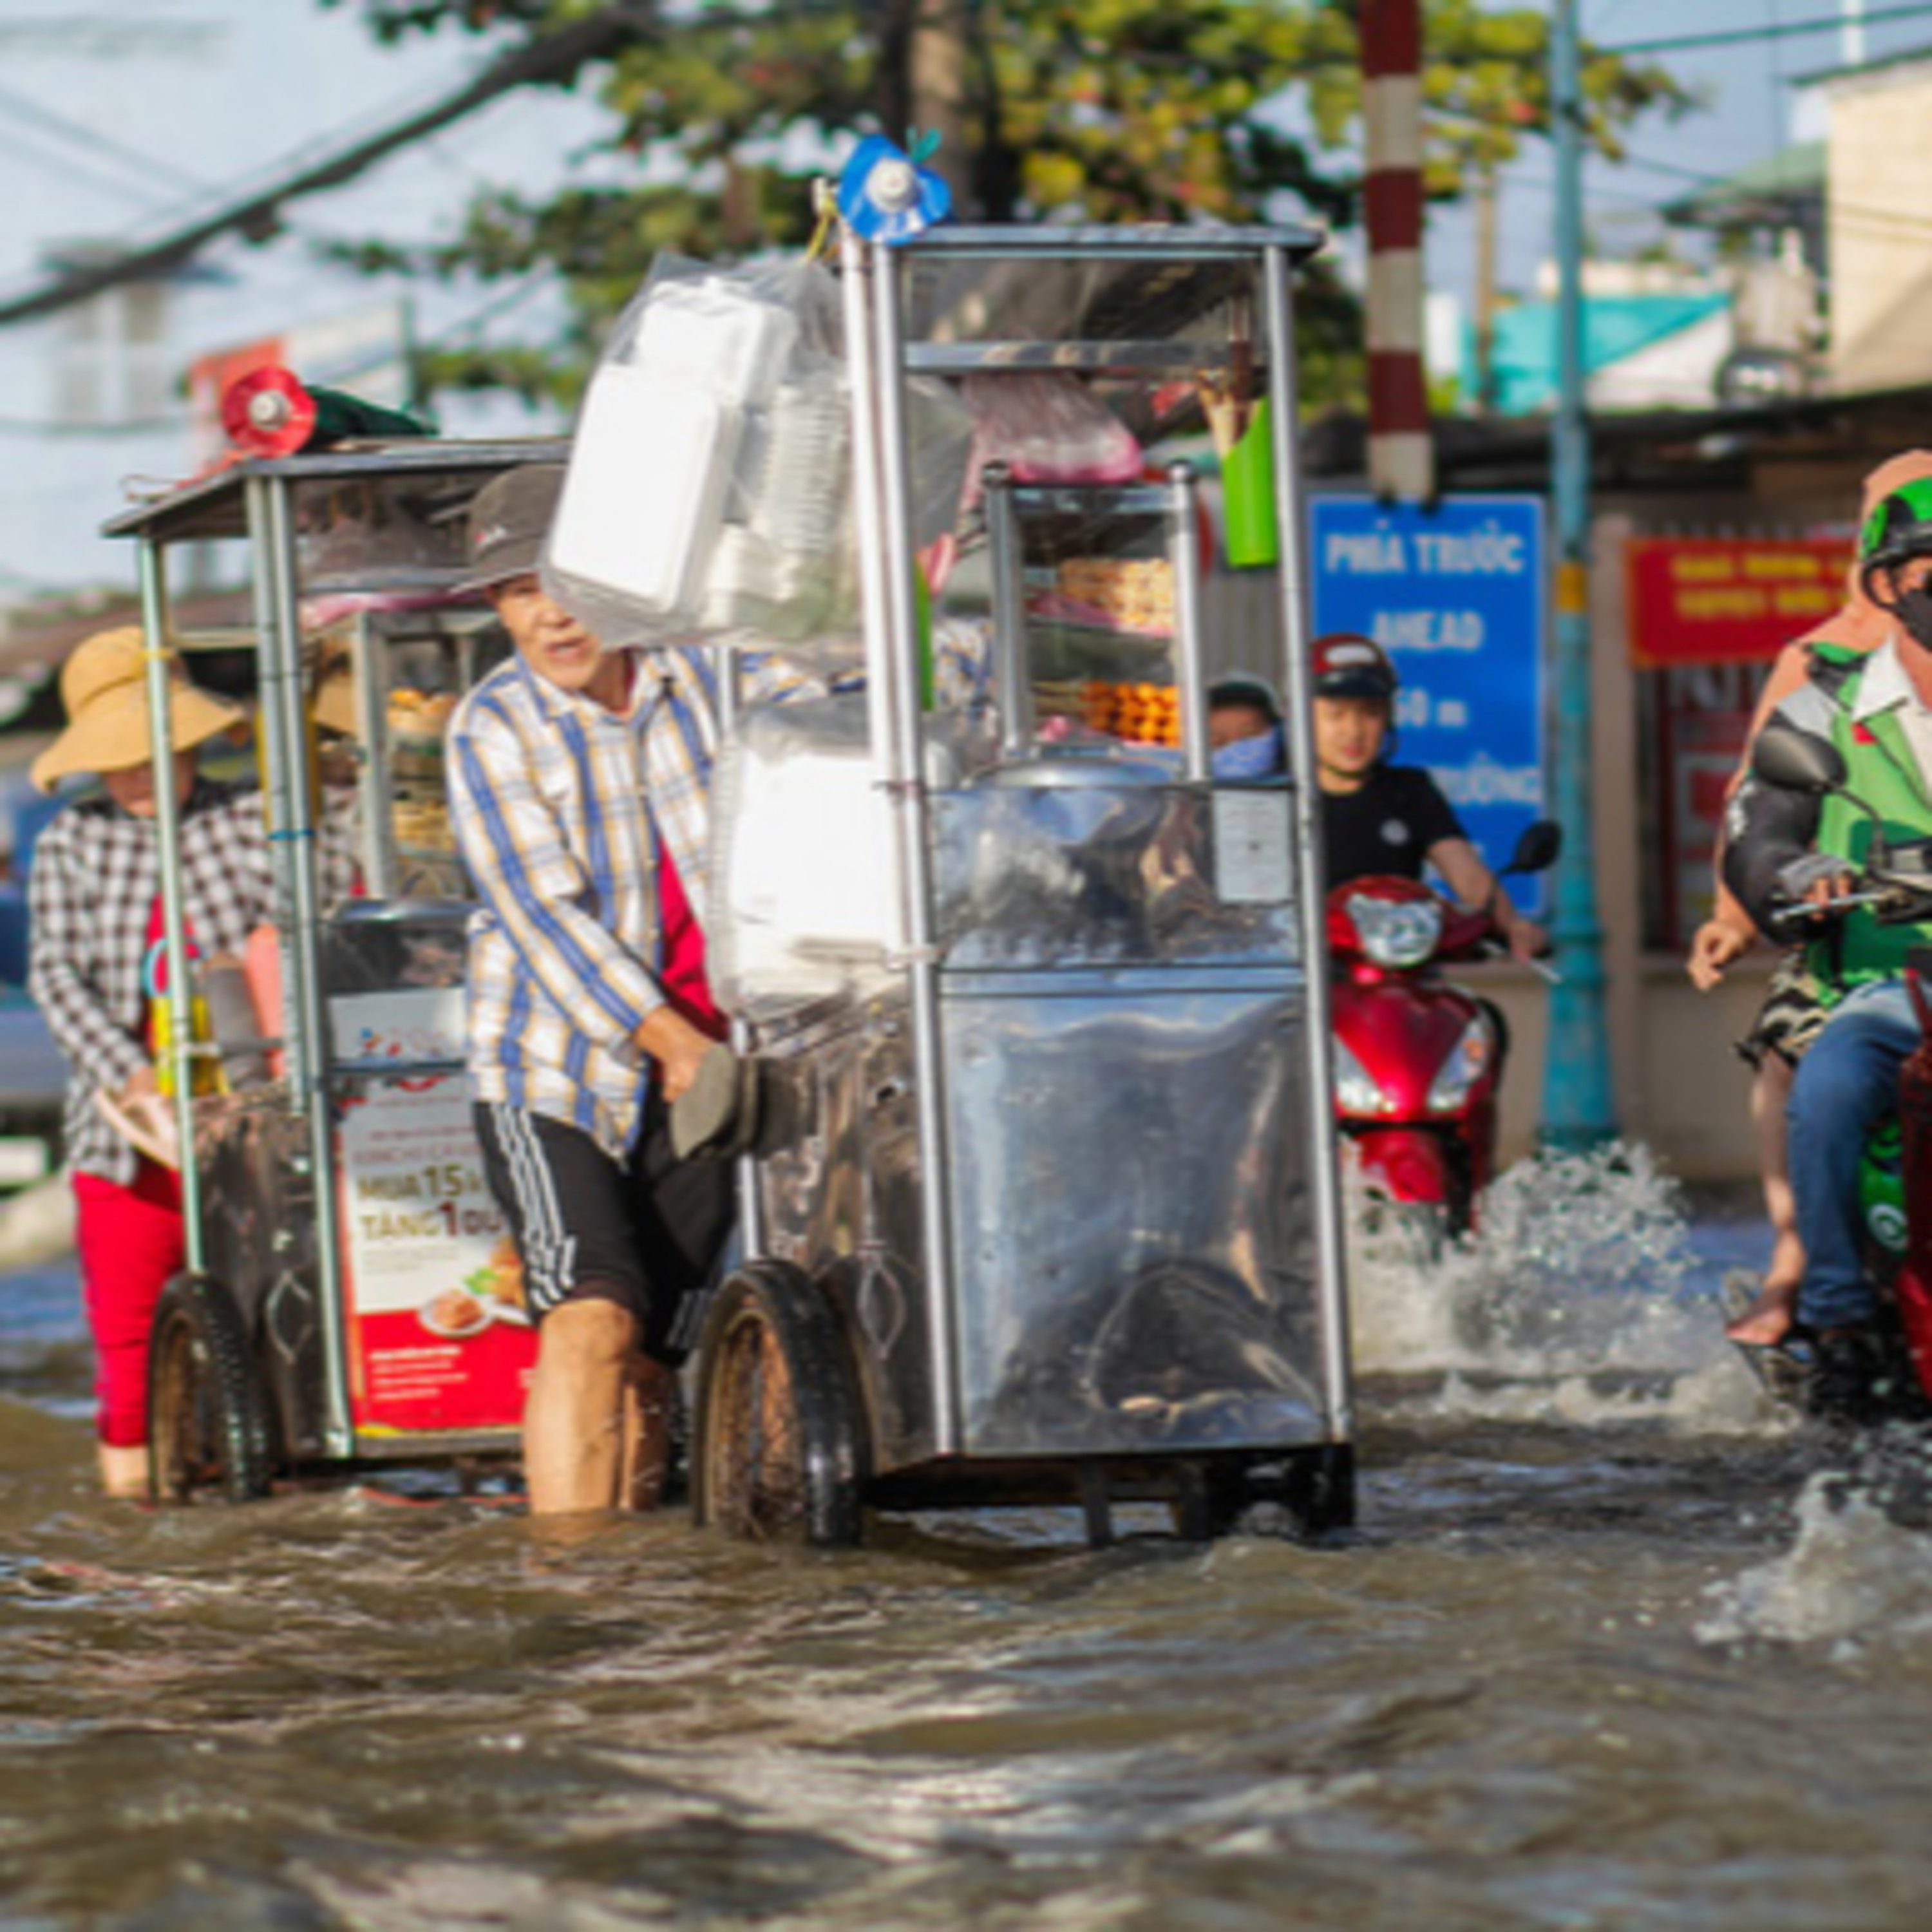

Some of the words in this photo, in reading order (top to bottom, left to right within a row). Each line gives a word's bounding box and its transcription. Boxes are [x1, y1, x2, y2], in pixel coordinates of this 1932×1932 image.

[1373, 612, 1484, 649] AHEAD
[1438, 701, 1468, 726] m
[423, 1164, 465, 1197] 15
[438, 1200, 458, 1238] 1
